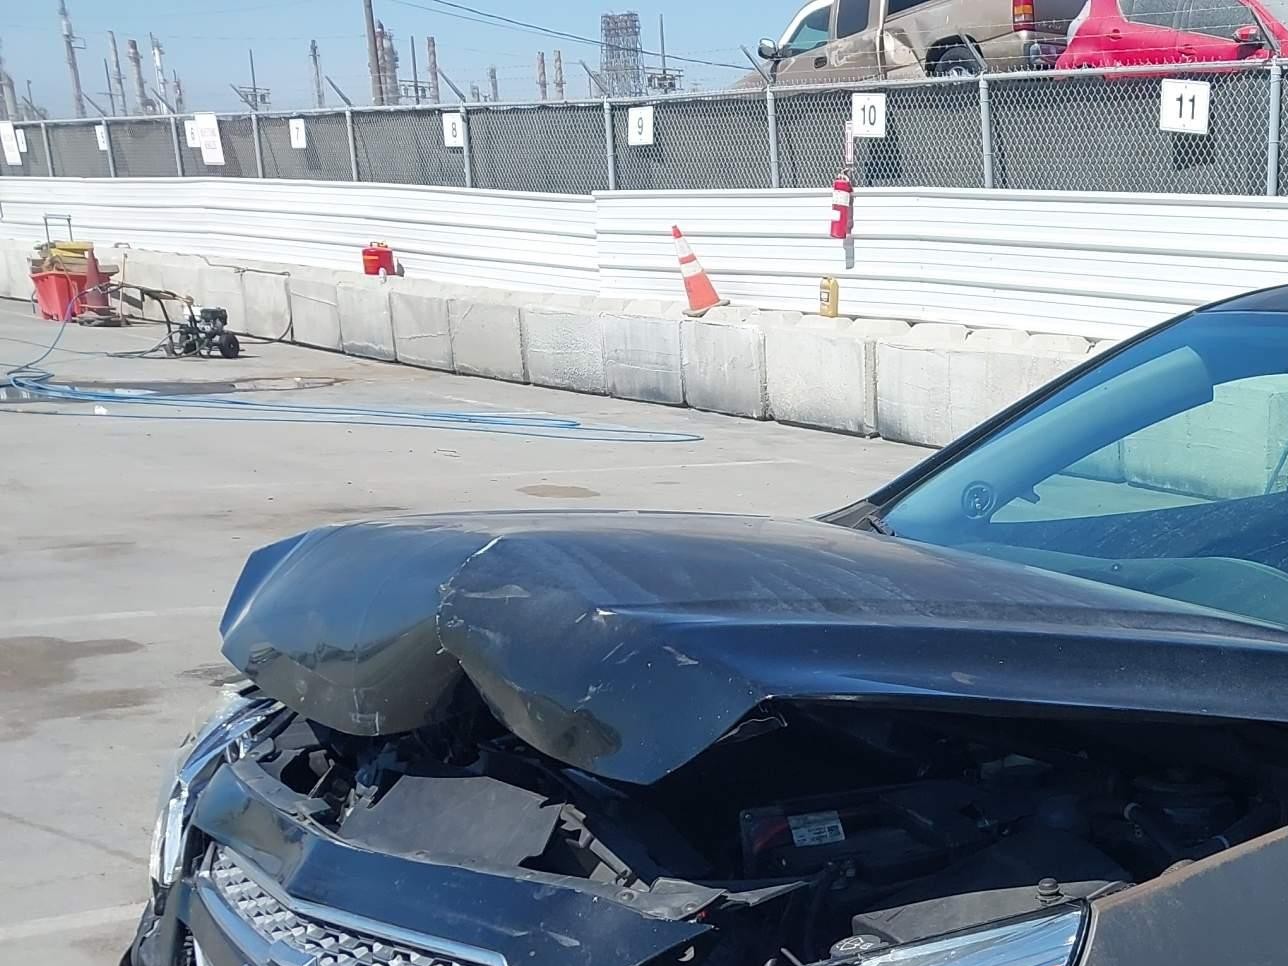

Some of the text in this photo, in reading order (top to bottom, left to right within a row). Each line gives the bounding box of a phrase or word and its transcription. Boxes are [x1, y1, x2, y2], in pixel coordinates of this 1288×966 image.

[860, 104, 877, 127] 10
[1175, 93, 1195, 120] 11
[294, 126, 300, 141] 7
[451, 122, 458, 138] 8
[637, 117, 644, 136] 9
